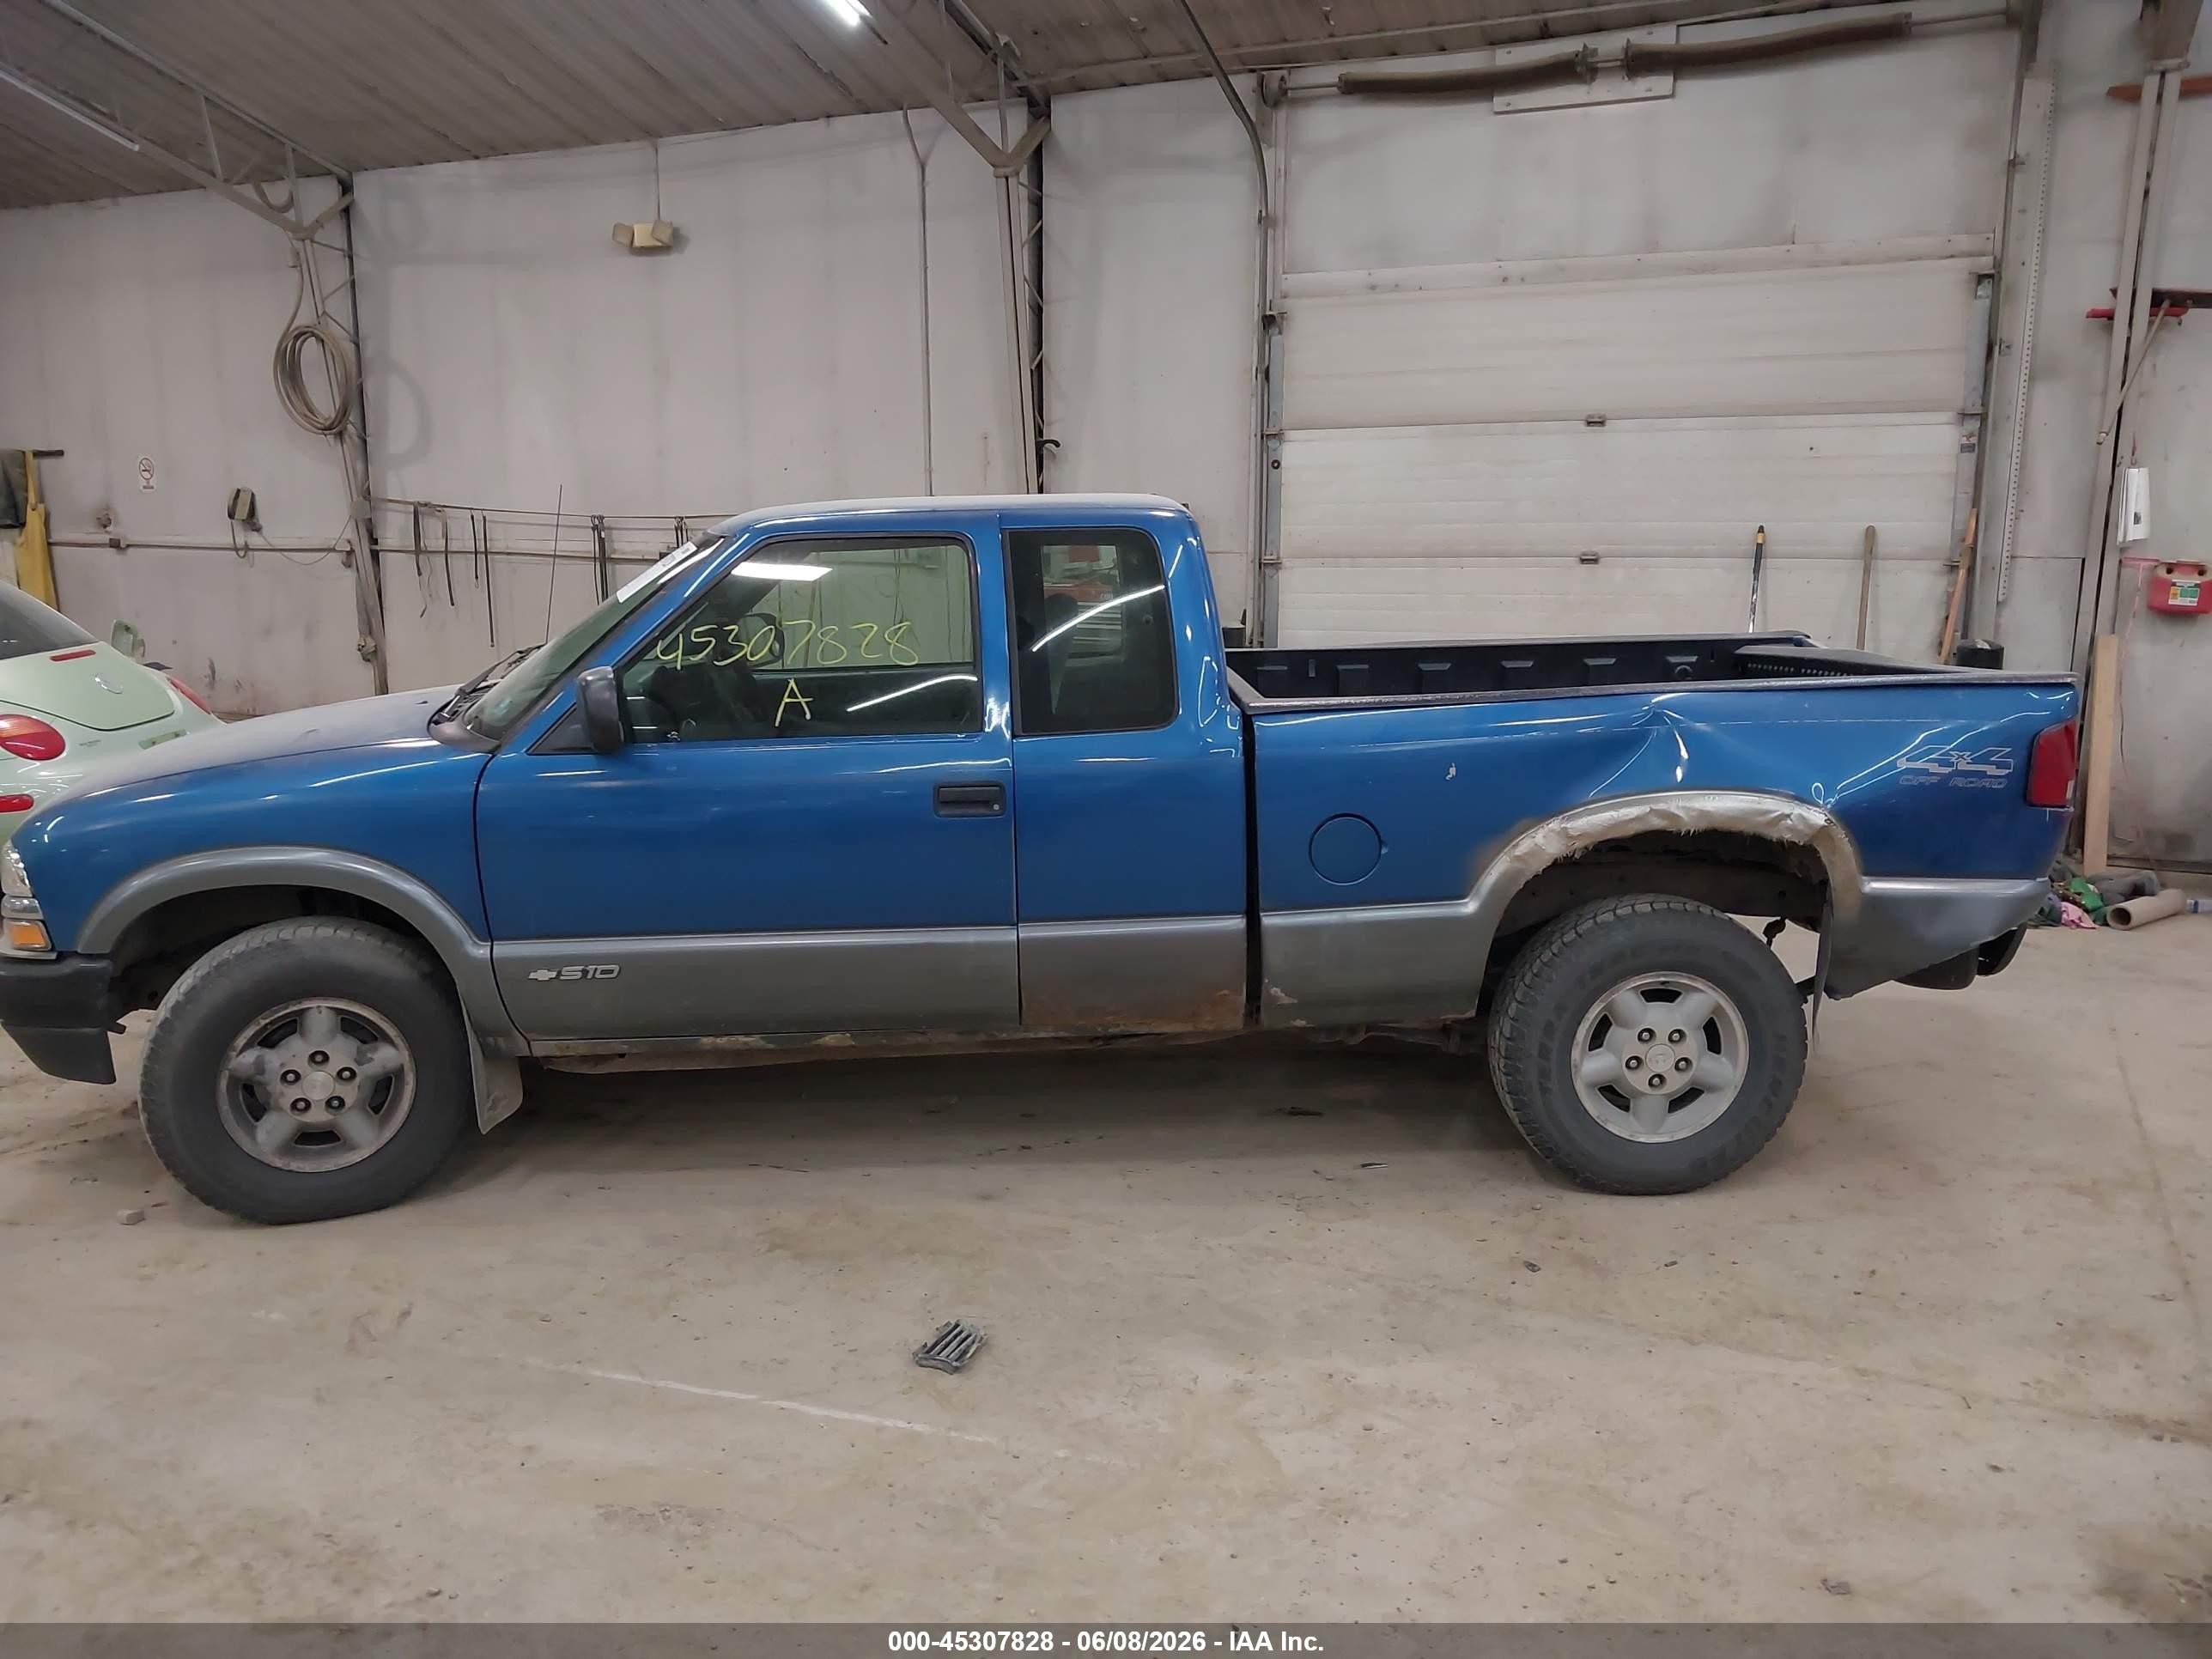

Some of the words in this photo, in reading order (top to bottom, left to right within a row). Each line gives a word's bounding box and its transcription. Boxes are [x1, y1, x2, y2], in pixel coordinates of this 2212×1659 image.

[656, 619, 921, 672] 45307828
[774, 678, 813, 727] A
[1898, 775, 1941, 786] OFF
[1948, 777, 2008, 789] ROAD
[559, 963, 621, 981] S10
